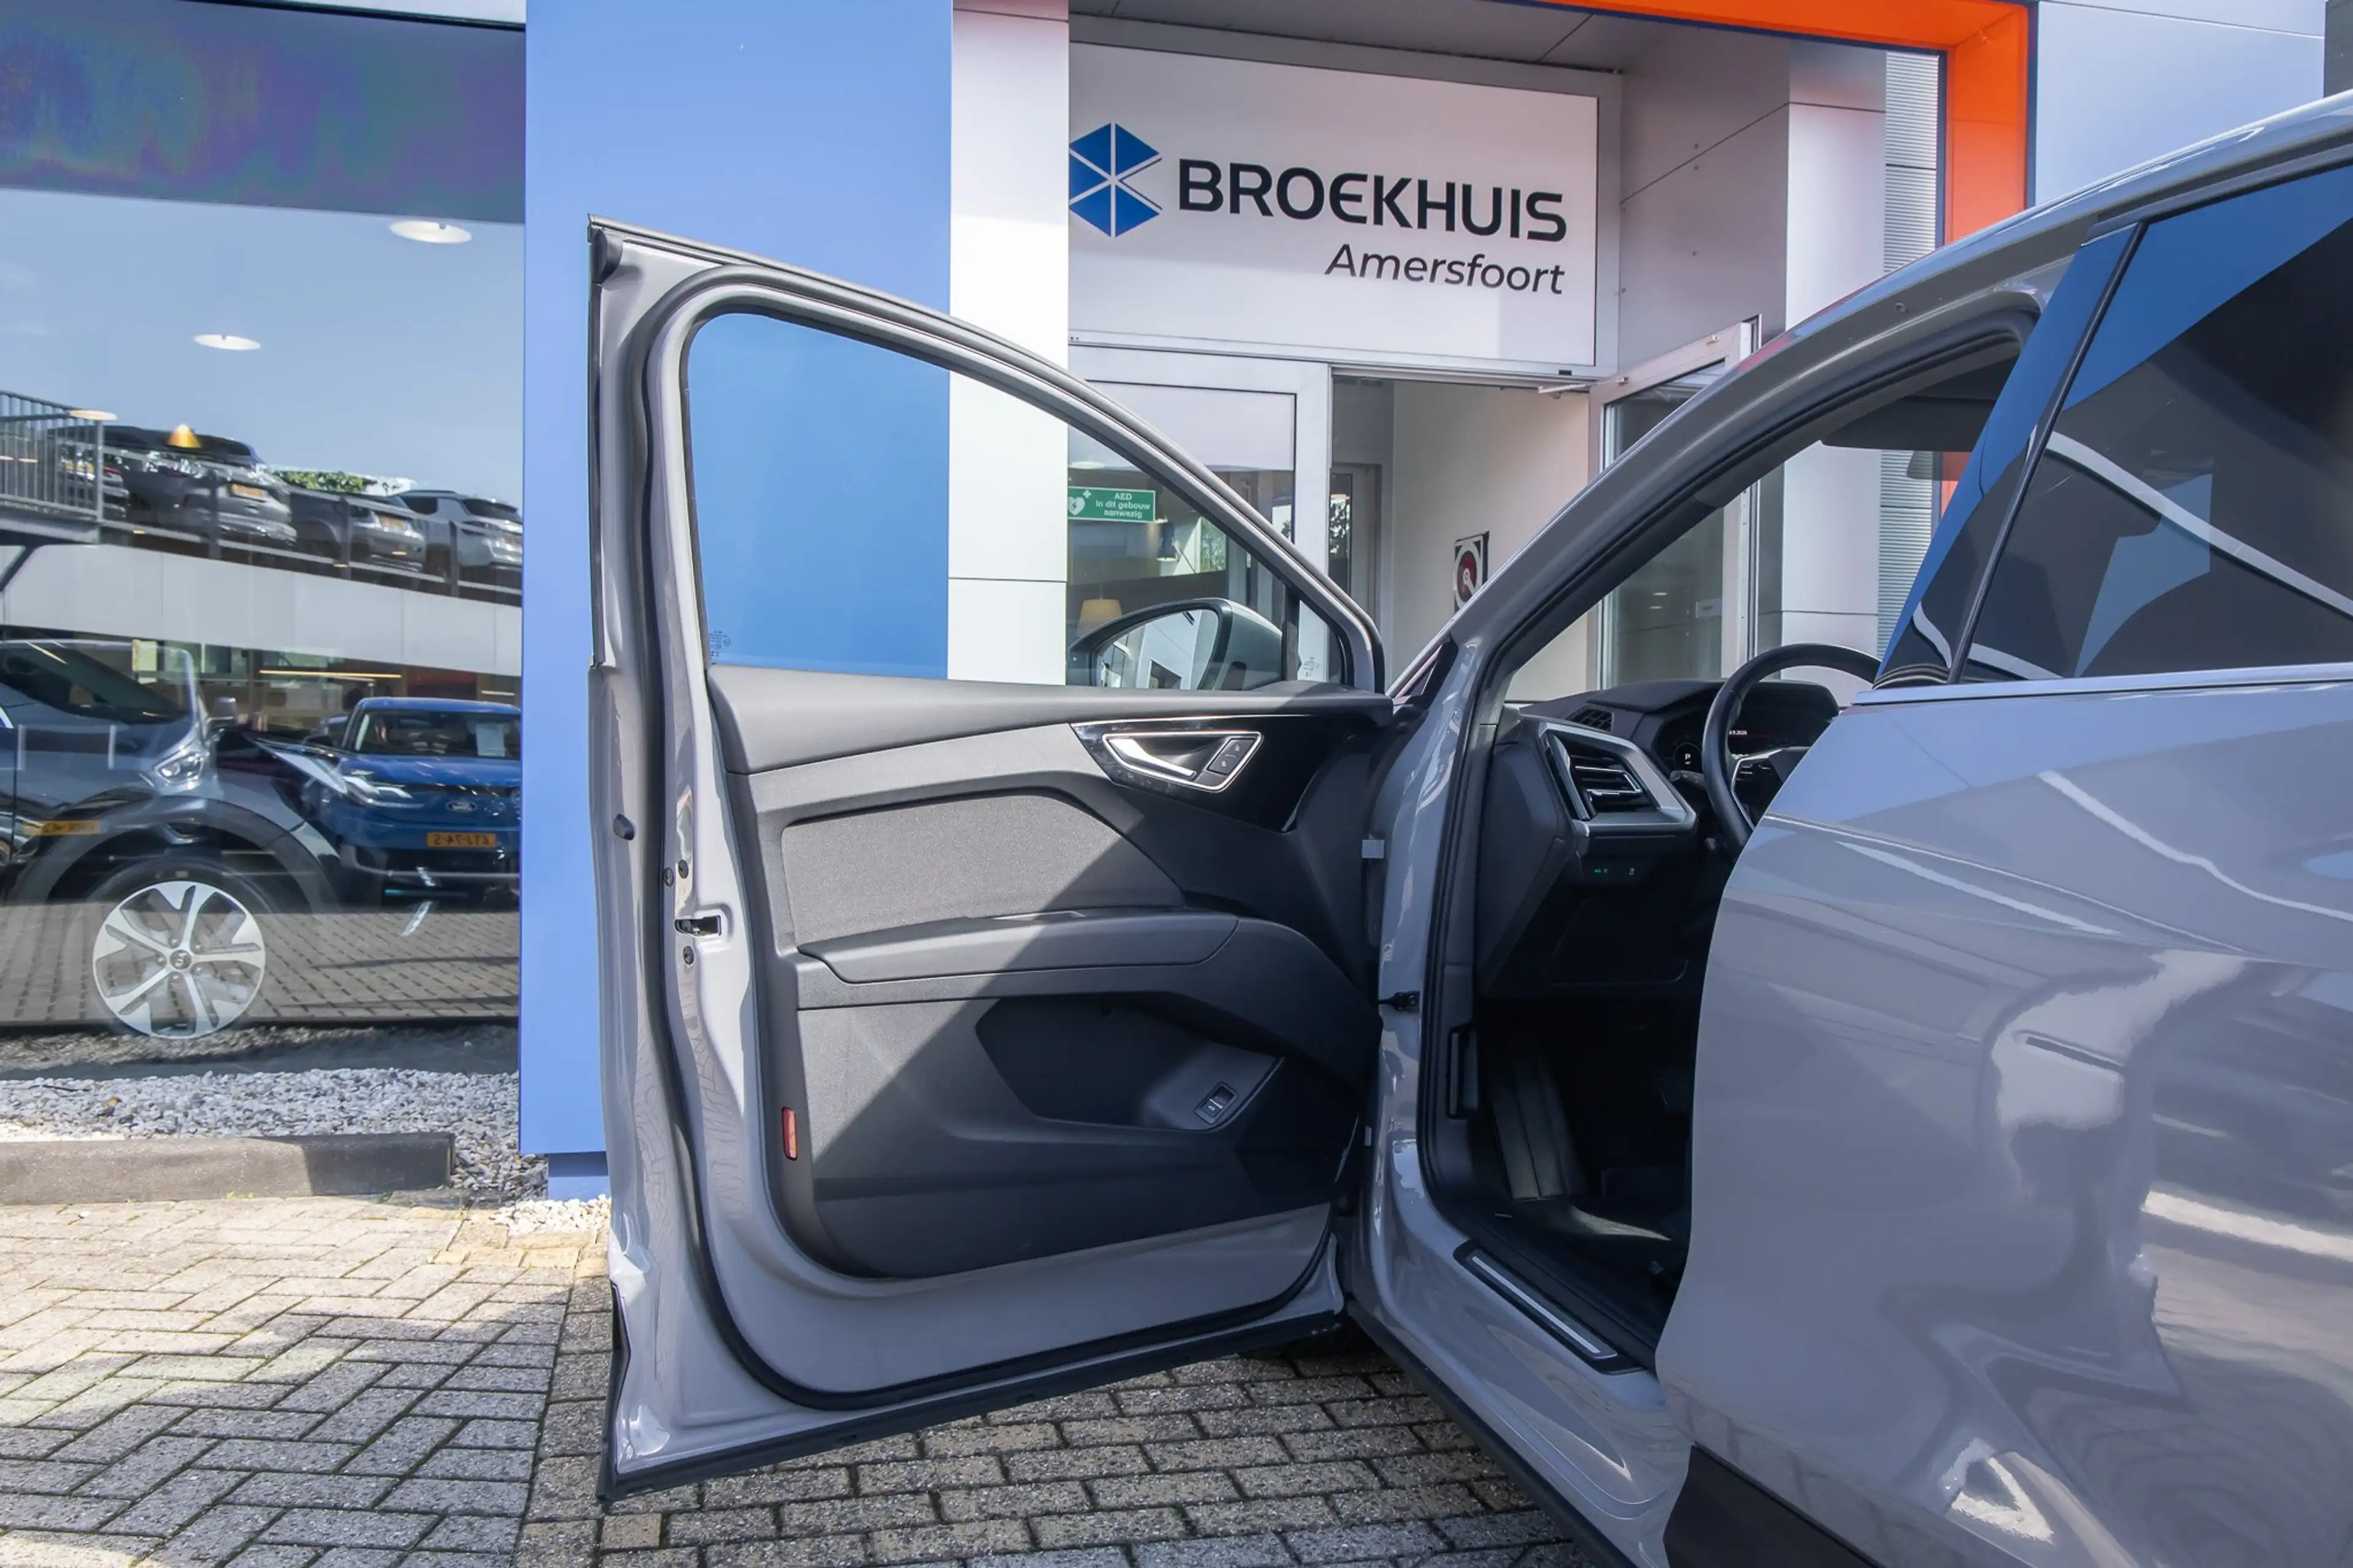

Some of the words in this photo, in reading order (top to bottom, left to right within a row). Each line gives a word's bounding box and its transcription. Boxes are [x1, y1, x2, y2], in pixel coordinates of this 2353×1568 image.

[1179, 158, 1567, 243] BROEKHUIS
[1325, 244, 1565, 294] Amersfoort
[1104, 510, 1142, 519] aanwezig
